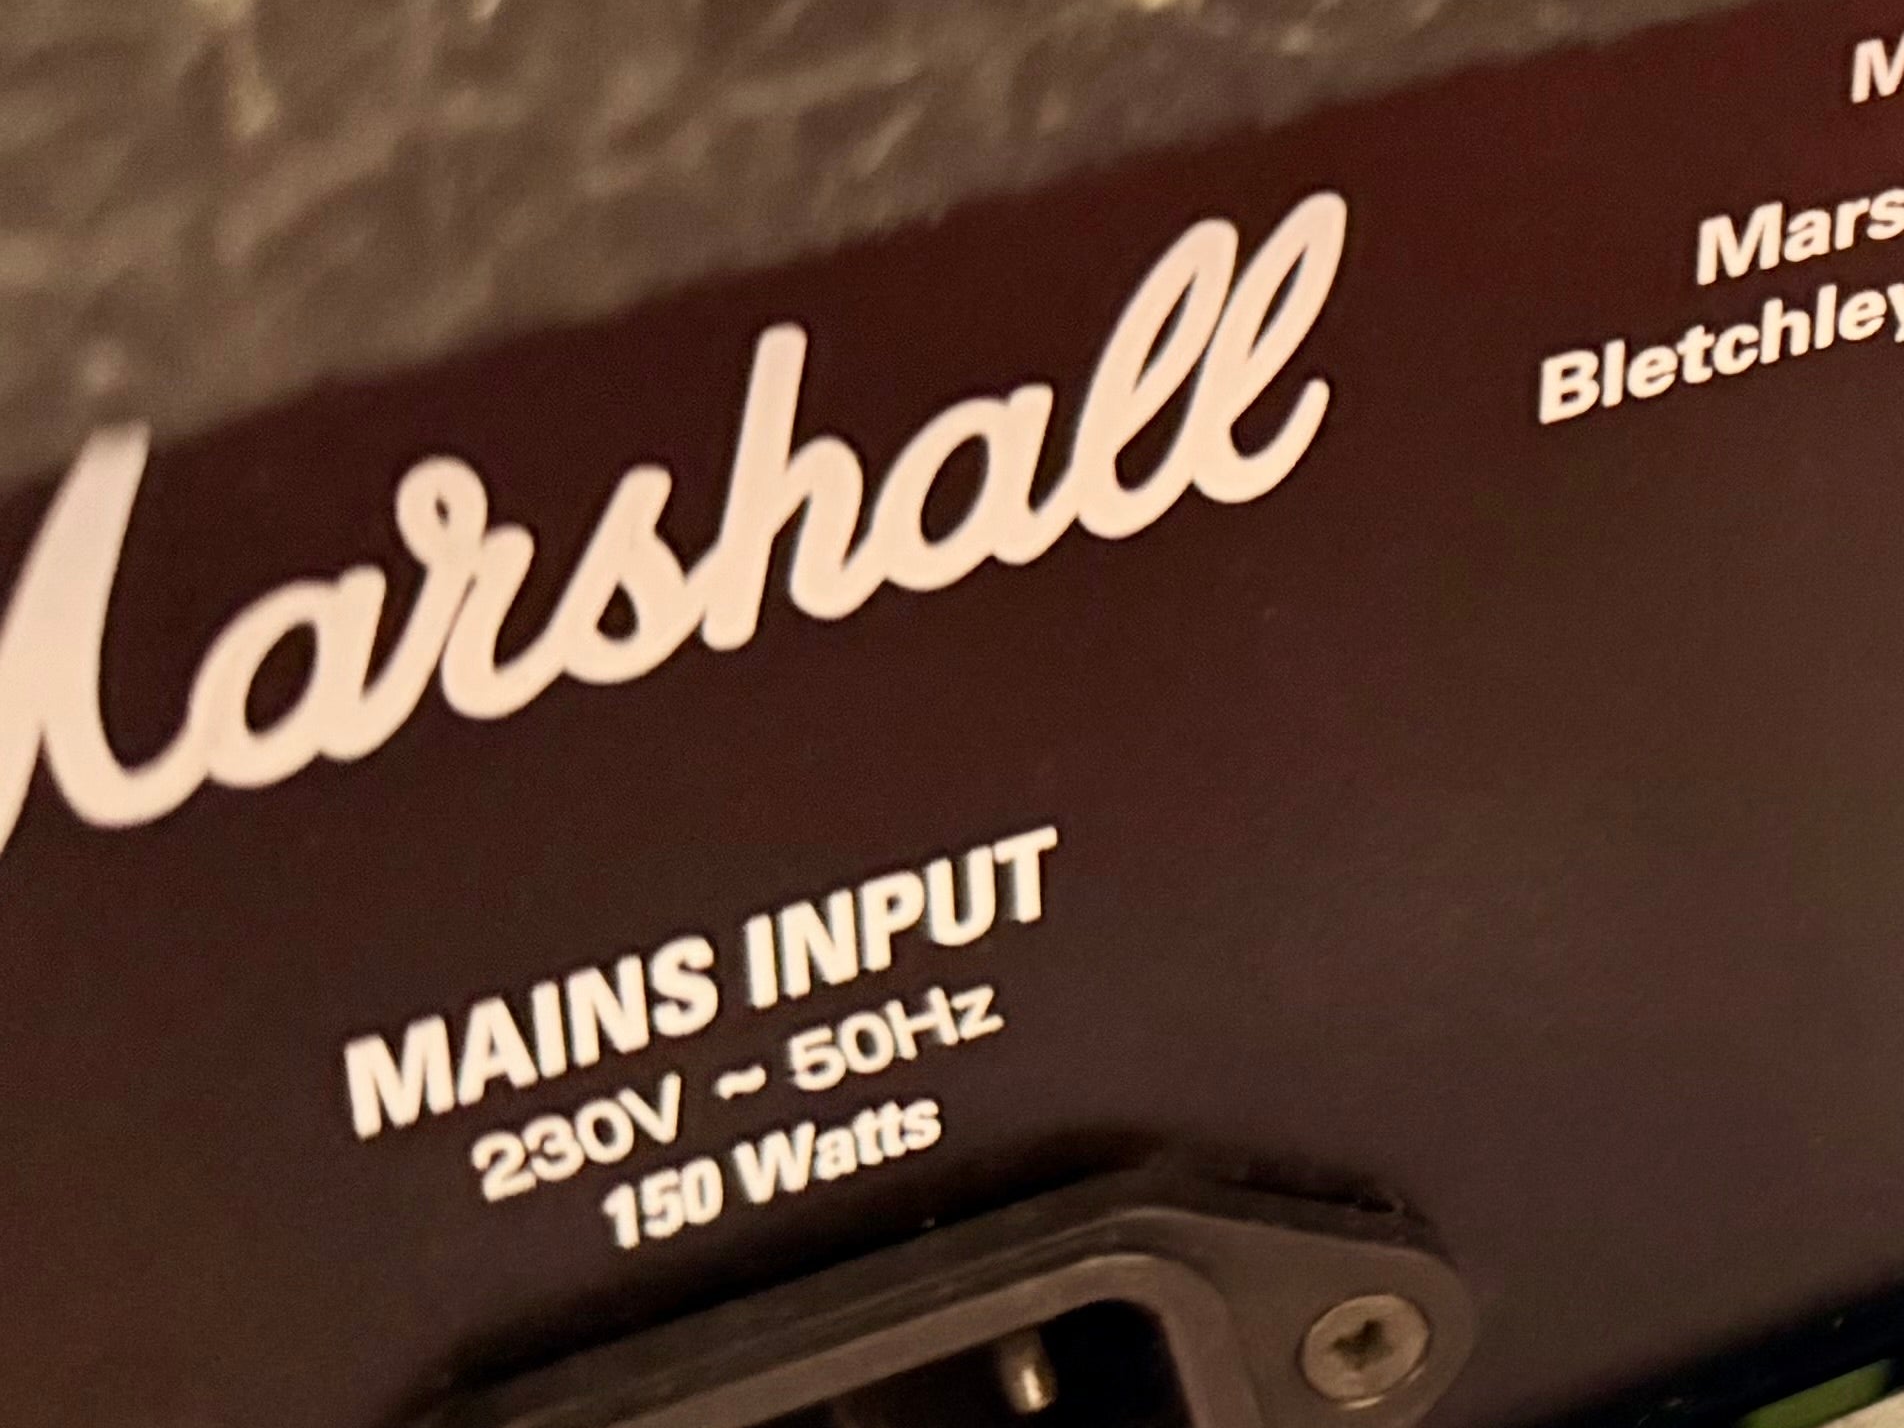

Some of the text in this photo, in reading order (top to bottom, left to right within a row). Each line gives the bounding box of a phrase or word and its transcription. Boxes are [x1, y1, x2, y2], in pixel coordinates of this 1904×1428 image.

[343, 824, 1059, 1140] MAINS INPUT
[470, 1072, 682, 1203] 230V
[787, 984, 1006, 1093] 50Hz
[602, 1098, 943, 1250] 150 Watts
